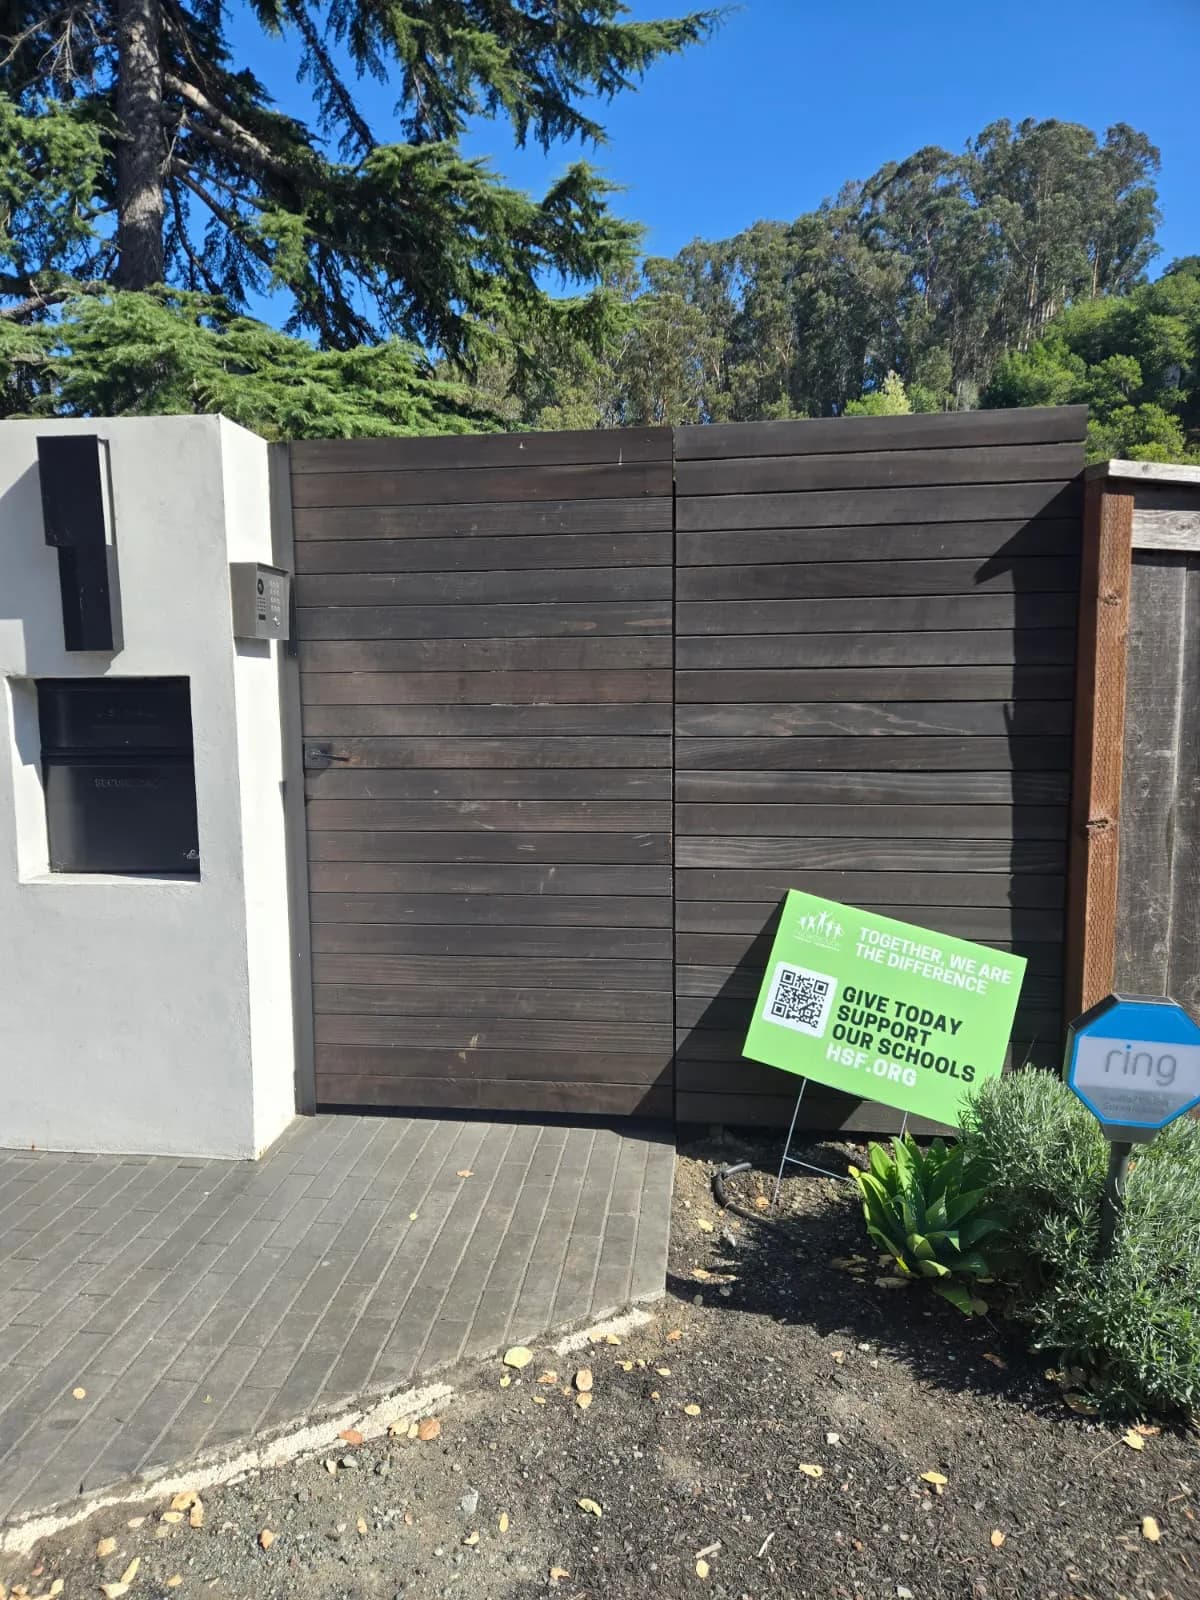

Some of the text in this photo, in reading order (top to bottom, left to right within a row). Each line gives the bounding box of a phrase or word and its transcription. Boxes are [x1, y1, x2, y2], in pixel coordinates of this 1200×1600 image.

[855, 943, 988, 995] THE DIFFERENCE
[860, 927, 944, 965] TOGETHER,
[950, 955, 976, 974] WE
[979, 964, 1012, 984] ARE
[837, 1005, 932, 1046] SUPPORT
[842, 986, 963, 1035] GIVE TODAY
[826, 1043, 917, 1087] HSF.ORG
[832, 1024, 976, 1082] OUR SCHOOLS
[1104, 1044, 1177, 1087] ring
